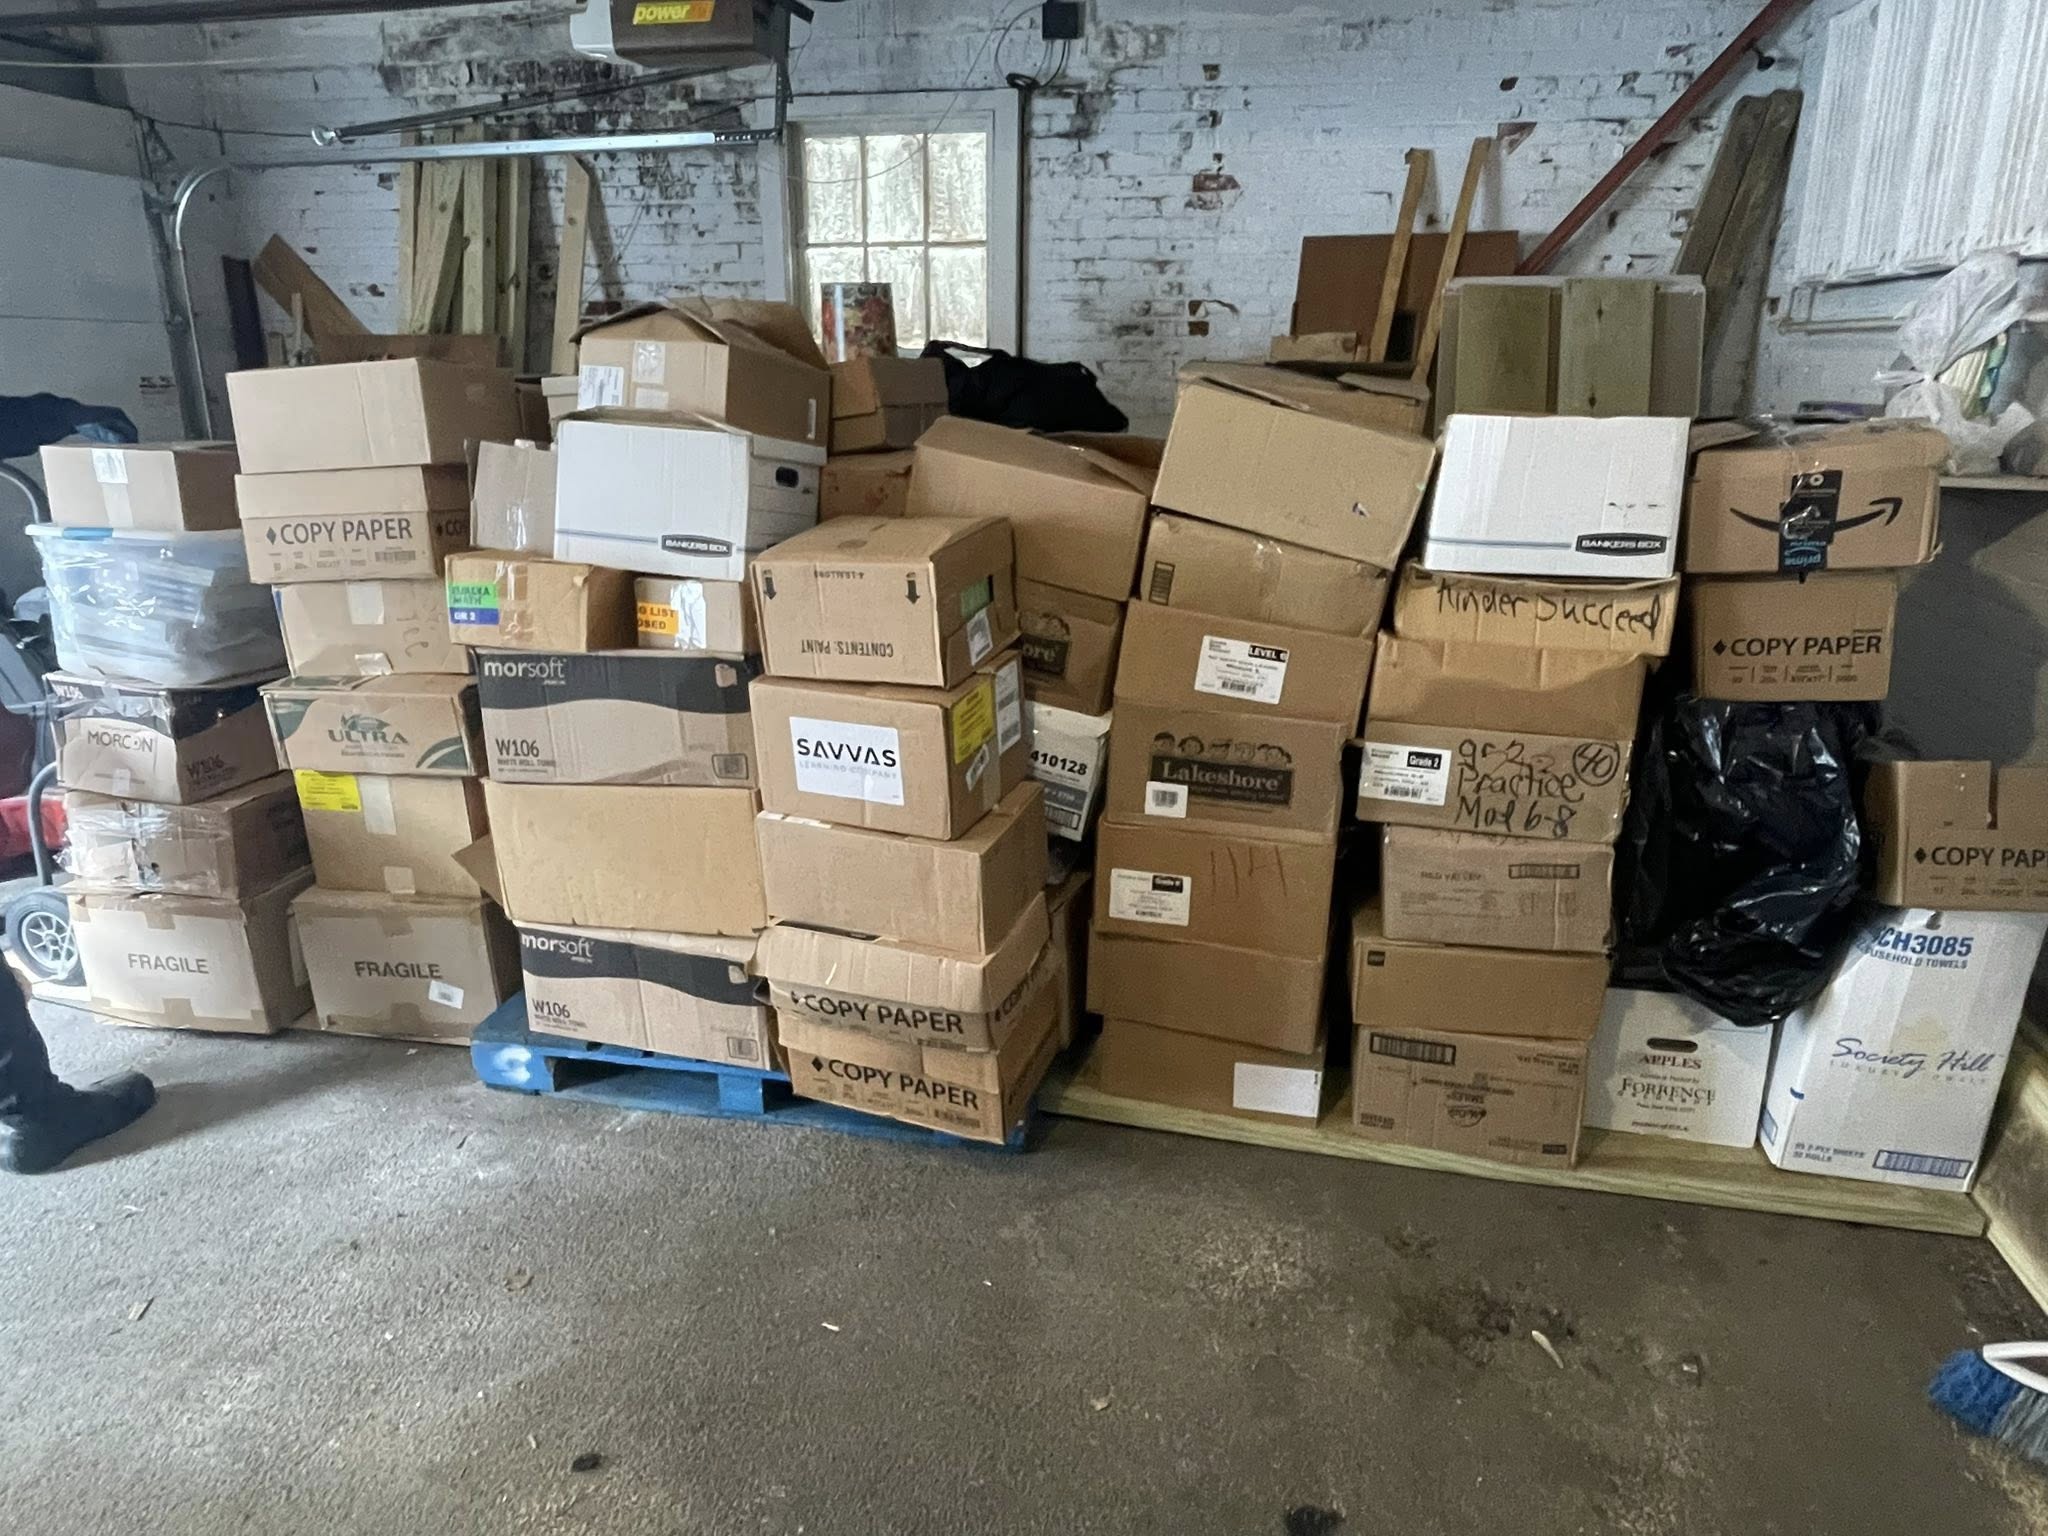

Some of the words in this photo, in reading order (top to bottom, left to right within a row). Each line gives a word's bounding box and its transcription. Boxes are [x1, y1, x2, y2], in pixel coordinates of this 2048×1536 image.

[636, 4, 690, 21] power
[281, 521, 336, 545] COPY
[343, 518, 413, 542] PAPER
[709, 544, 729, 553] BOX
[1581, 540, 1635, 549] BANKERS
[1637, 540, 1661, 549] BOX
[650, 606, 675, 618] LIST
[1437, 578, 1529, 618] Kinder
[1535, 594, 1661, 641] Succeed
[801, 639, 831, 655] PAINT
[1249, 646, 1277, 660] LEVEL
[1731, 638, 1798, 657] COPY
[1803, 635, 1882, 655] PAPER
[484, 657, 565, 678] morsoft
[328, 729, 409, 744] ULTRA
[495, 738, 540, 758] W106
[797, 738, 897, 768] SAVVAS
[1031, 750, 1088, 775] 410128
[1410, 755, 1433, 768] Grade
[1433, 757, 1440, 768] 2
[1162, 761, 1279, 791] Lakeshore
[1931, 846, 1996, 867] COPY
[2001, 848, 2048, 868] PAP
[521, 933, 594, 957] morsoft
[1873, 927, 1974, 957] CH3085
[127, 953, 209, 975] FRAGILE
[354, 960, 443, 979] FRAGILE
[1869, 950, 1922, 968] USEHOLD
[1926, 957, 1968, 970] TOWELS
[531, 998, 571, 1019] W106
[803, 994, 869, 1022] COPY
[877, 1005, 965, 1035] PAPER
[1640, 1054, 1702, 1070] APPLES
[1832, 1037, 1928, 1079] Society
[1936, 1050, 1994, 1073] Hill
[828, 1059, 893, 1089] COPY
[901, 1073, 979, 1111] PAPER
